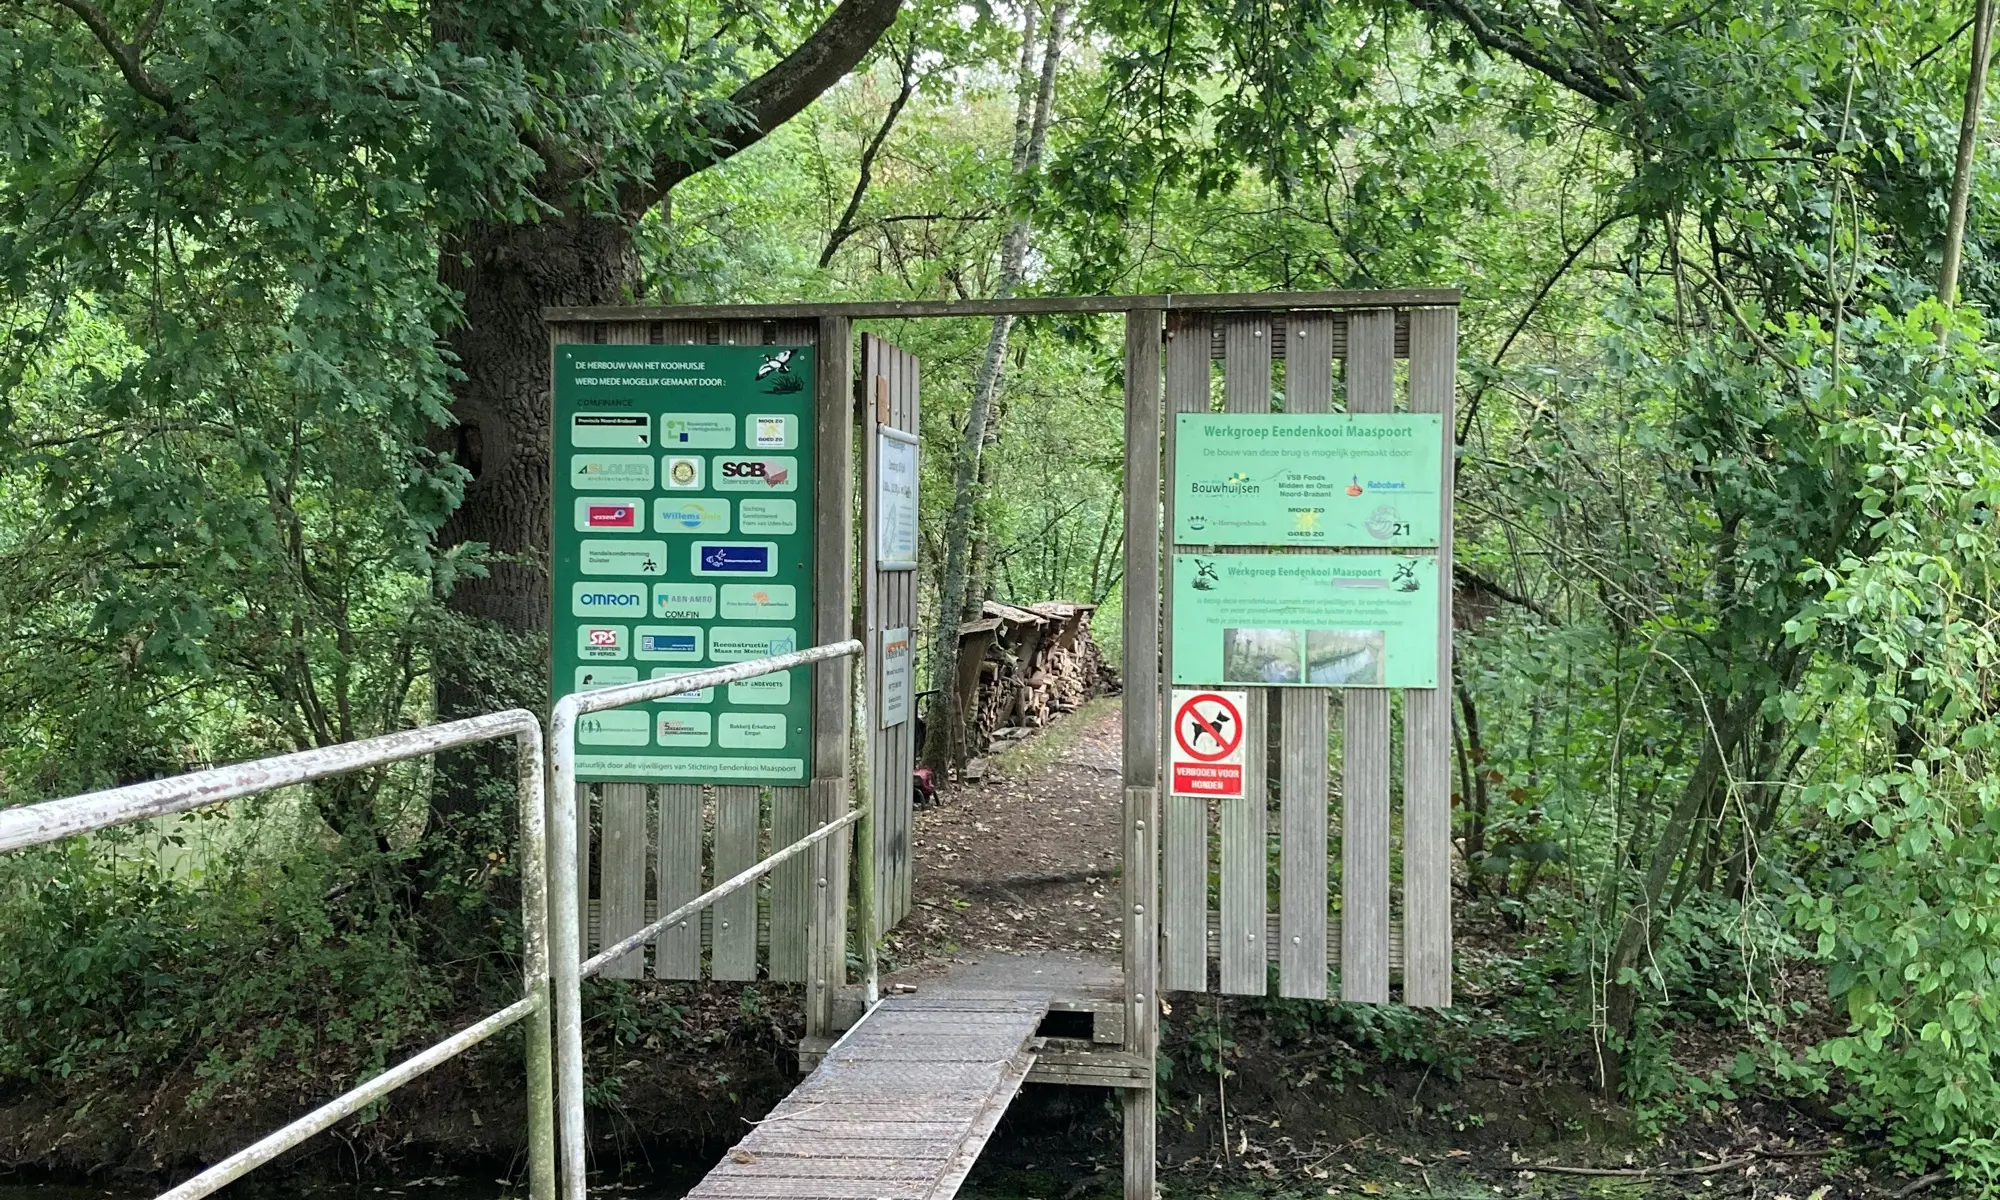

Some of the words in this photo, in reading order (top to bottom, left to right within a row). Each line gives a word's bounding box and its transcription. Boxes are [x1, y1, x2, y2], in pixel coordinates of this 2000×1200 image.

[576, 362, 586, 370] DE
[588, 362, 626, 370] HERBOUW
[627, 362, 643, 370] VAN
[645, 362, 660, 370] HET
[661, 362, 706, 370] KOOIHUISJE
[575, 377, 598, 385] WERD
[599, 377, 621, 385] MEDE
[622, 377, 660, 386] MOGELIJK
[661, 378, 698, 386] GEMAAKT
[699, 378, 722, 386] DOOR
[1204, 426, 1269, 439] Werkgroep
[1272, 426, 1342, 437] Eendenkooi
[1346, 426, 1412, 439] Maaspoort
[1203, 448, 1215, 457] De
[1217, 448, 1241, 457] bouw
[1260, 448, 1279, 457] deze
[1281, 448, 1301, 458] brug
[1312, 449, 1348, 459] mogelijk
[1350, 449, 1387, 459] gemaakt
[722, 462, 766, 477] SCB
[1192, 482, 1260, 494] Bouwhuijsen
[1393, 524, 1410, 536] 21
[1228, 567, 1276, 577] Werkgroep
[1278, 567, 1330, 576] Eendenkooi
[1333, 568, 1381, 578] Maaspoort
[581, 594, 639, 605] OMRON
[590, 631, 616, 645] SPS
[688, 763, 718, 771] Stichting
[760, 765, 796, 773] Maaspoort
[1177, 767, 1216, 777] VERBODEN
[1218, 768, 1240, 778] VOOR
[1192, 780, 1223, 790] HONDEN
